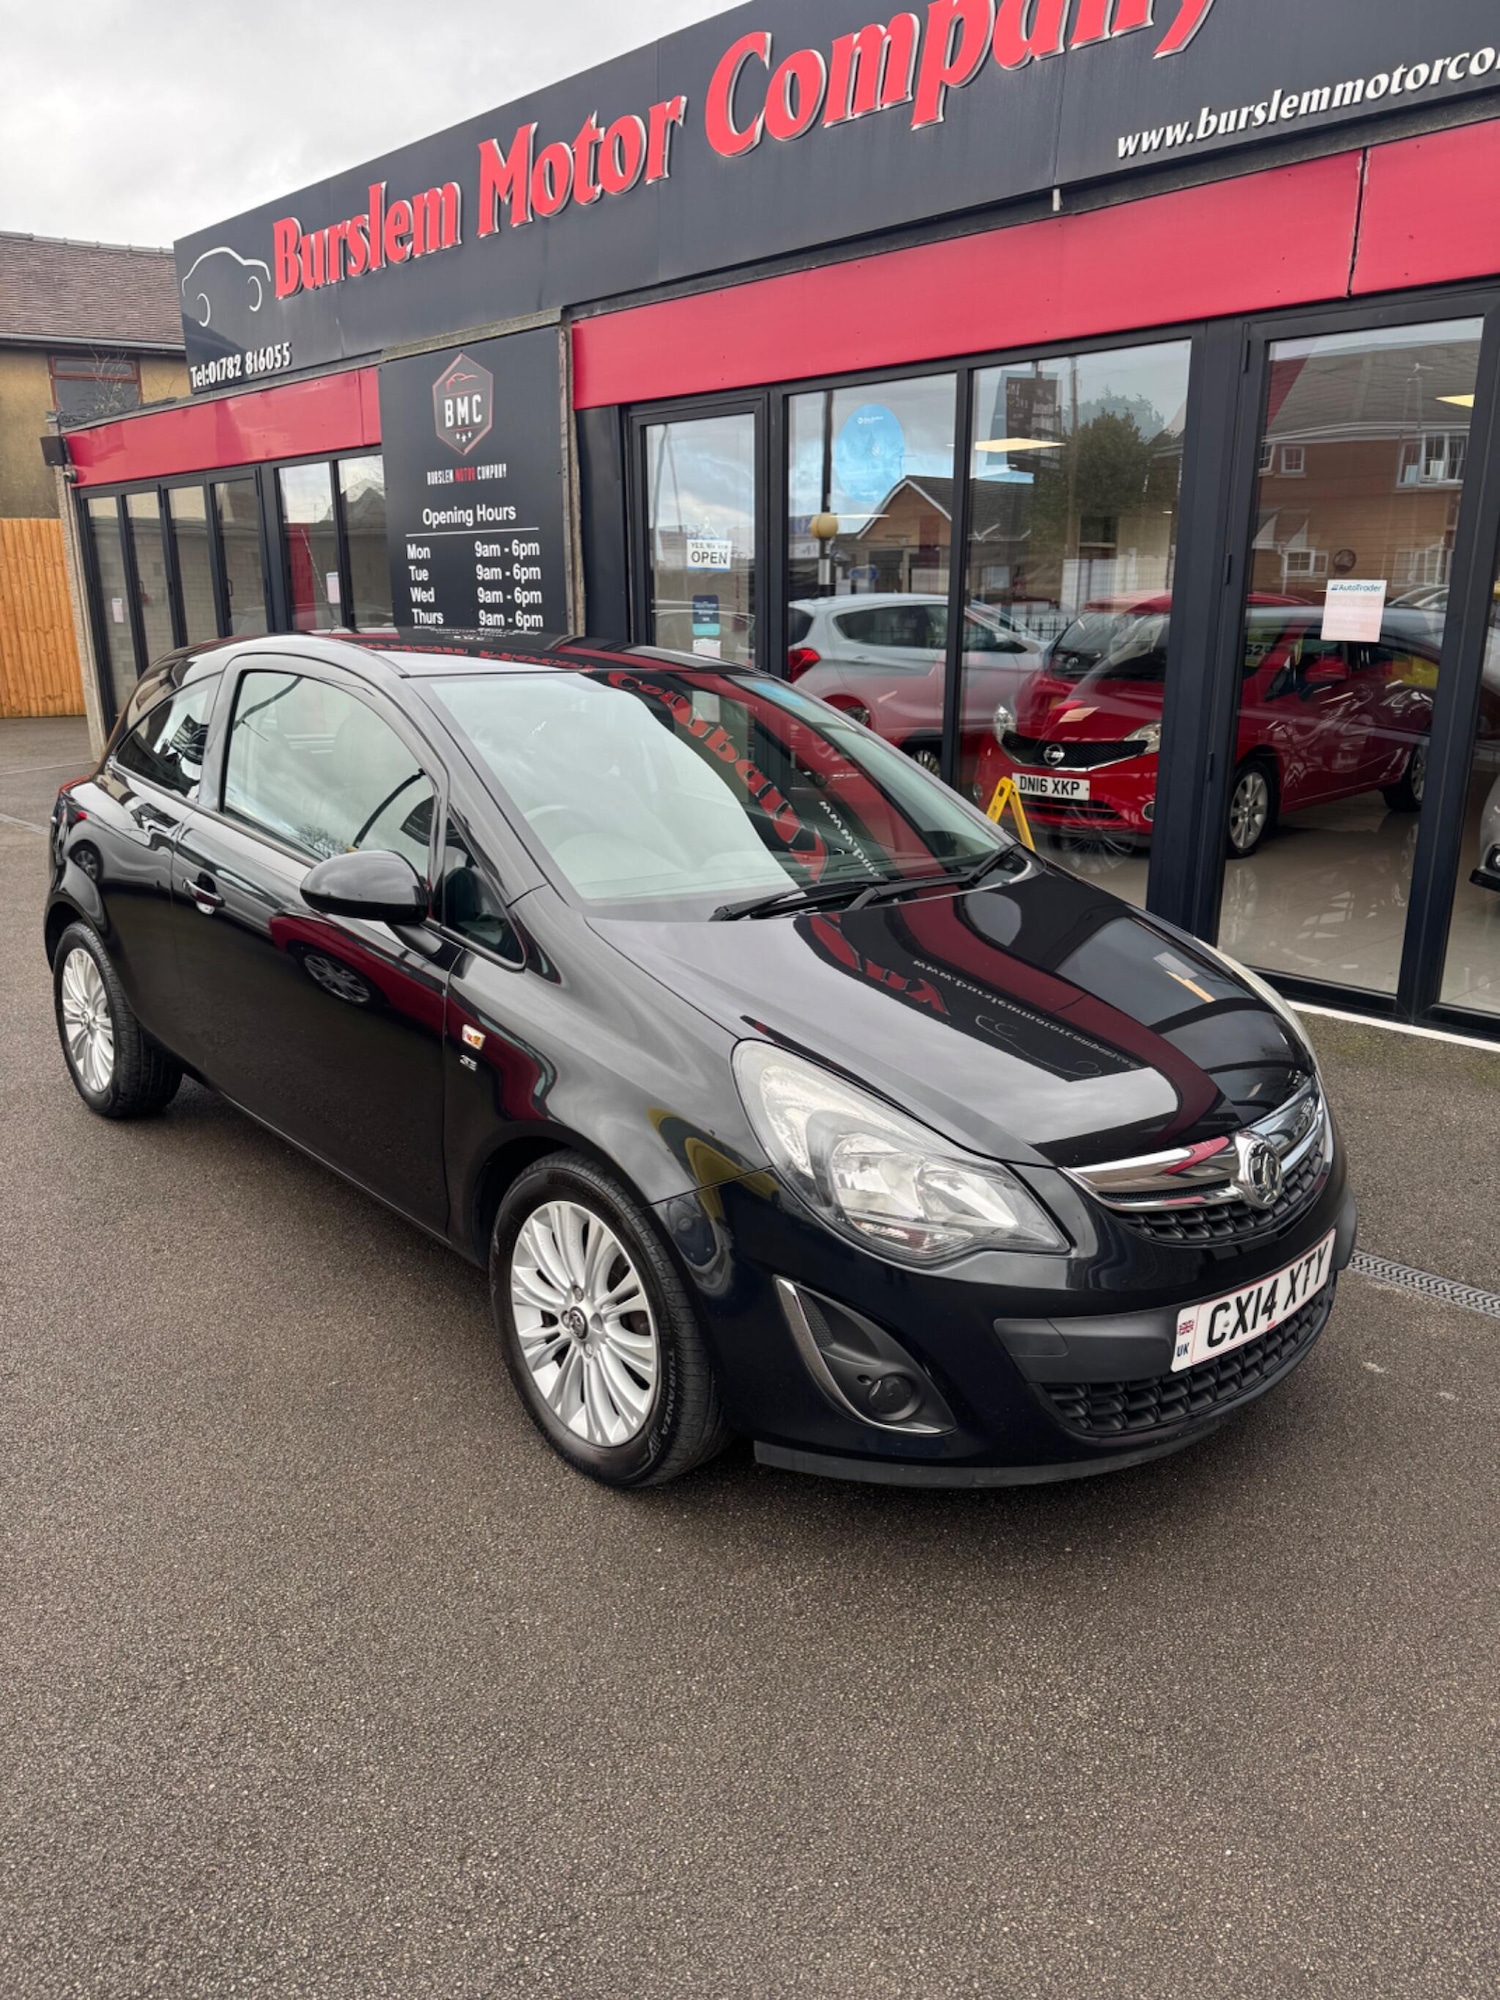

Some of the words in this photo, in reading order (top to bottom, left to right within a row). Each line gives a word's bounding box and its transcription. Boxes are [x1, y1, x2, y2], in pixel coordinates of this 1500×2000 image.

[1117, 46, 1500, 158] www.burslemmotorco
[273, 180, 462, 300] Burslem
[477, 95, 688, 238] Motor
[190, 354, 242, 388] Tel:01782
[245, 341, 292, 375] 816055
[444, 394, 483, 428] BMC
[422, 505, 474, 528] Opening
[476, 504, 517, 522] Hours
[407, 544, 431, 559] Mon
[475, 540, 501, 557] 9am
[511, 539, 540, 560] 6pm
[691, 551, 728, 564] OPEN
[408, 565, 429, 581] Tue
[476, 564, 502, 580] 9am
[513, 563, 542, 583] 6pm
[410, 587, 435, 603] Wed
[477, 587, 503, 603] 9am
[514, 587, 543, 606] 6pm
[1339, 583, 1382, 592] AutoTrader
[411, 608, 444, 625] Thurs
[478, 610, 505, 626] 9am
[515, 609, 544, 631] 6pm
[1019, 776, 1048, 793] DN16
[1051, 779, 1081, 796] XKP
[1206, 1278, 1280, 1349] CX14
[1283, 1240, 1330, 1311] XTY
[1176, 1342, 1190, 1358] UK
[661, 1347, 676, 1436] TURANZA
